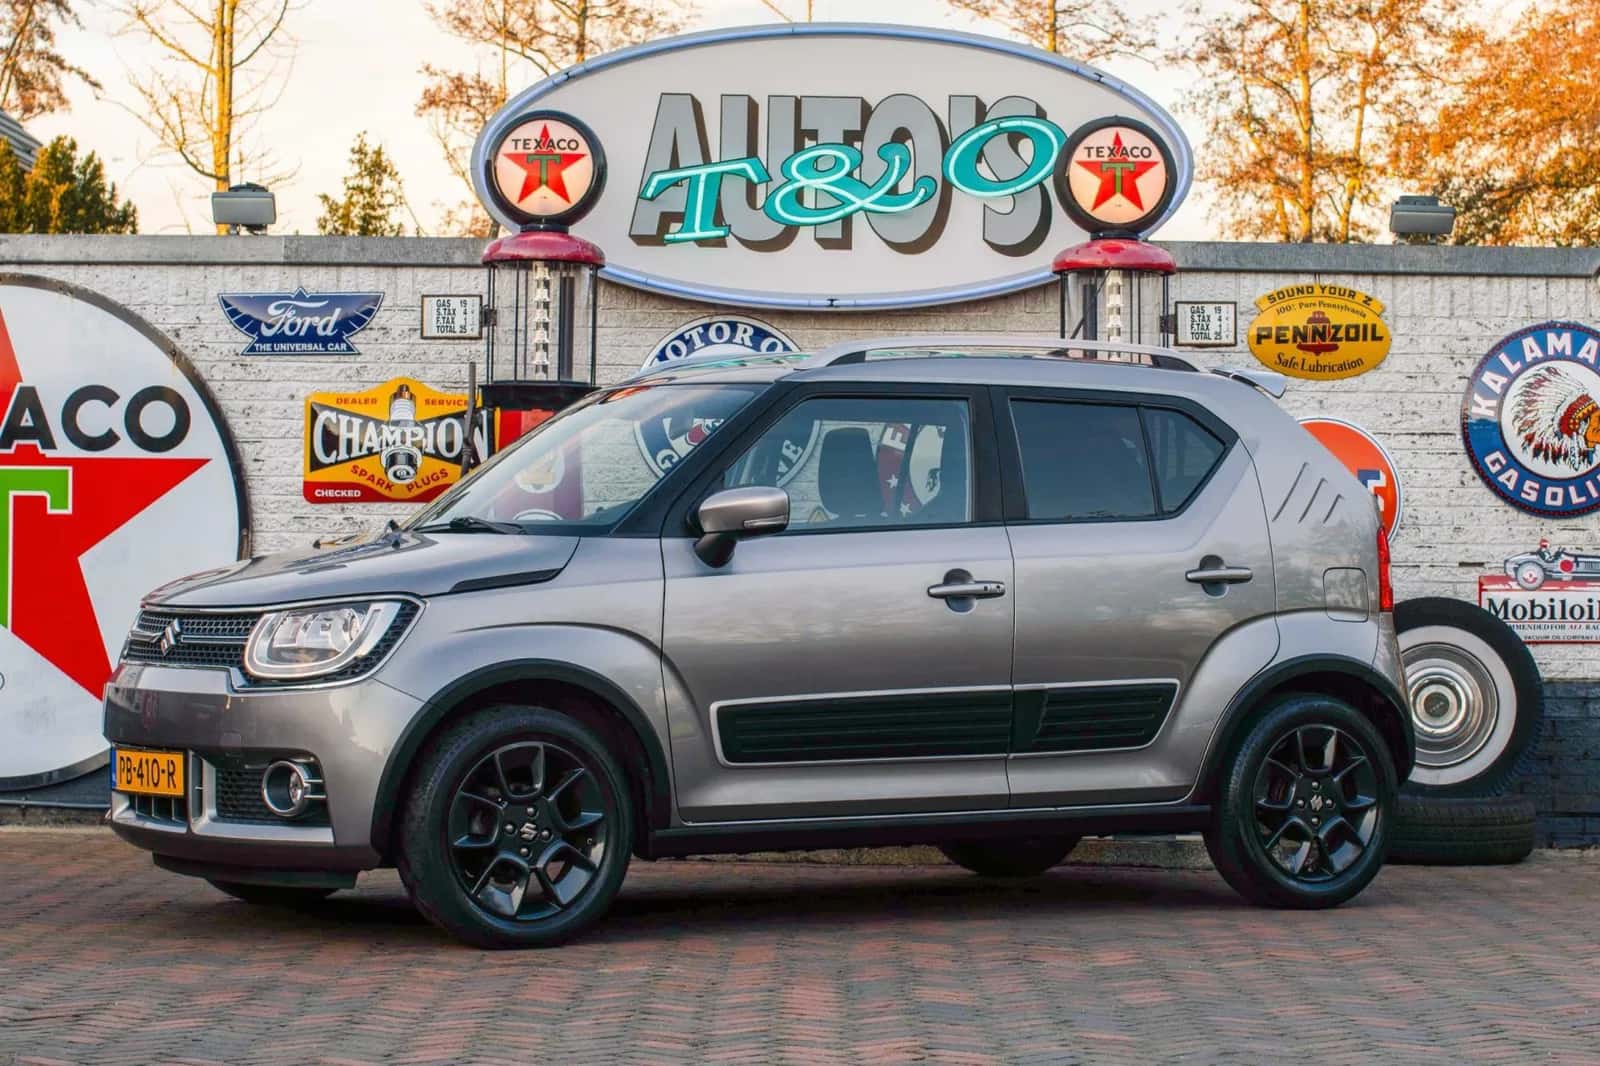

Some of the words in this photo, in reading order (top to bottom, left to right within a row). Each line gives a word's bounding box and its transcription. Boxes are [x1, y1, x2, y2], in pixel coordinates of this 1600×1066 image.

[511, 138, 580, 151] TEXACO
[1083, 146, 1152, 159] TEXACO
[629, 93, 1051, 254] AUTO'S
[436, 299, 451, 308] GAS
[1267, 285, 1315, 304] SOUND
[1319, 285, 1356, 300] YOUR
[260, 300, 342, 337] Ford
[1190, 306, 1205, 314] GAS
[1299, 301, 1317, 310] Pure
[1318, 300, 1367, 319] Pennsylvania
[436, 325, 456, 333] TOTAL
[1190, 331, 1212, 340] TOTAL
[1256, 323, 1384, 345] PENNZOIL
[254, 342, 272, 351] THE
[273, 342, 325, 351] UNIVERSAL
[327, 342, 347, 351] CAR
[655, 322, 754, 361] OTOR
[1274, 352, 1298, 370] Safe
[1300, 356, 1364, 373] Lubrication
[1472, 332, 1600, 417] KALAMA
[0, 385, 191, 453] ACO
[350, 464, 395, 492] SPARK
[406, 468, 449, 492] PLUGS
[1483, 451, 1600, 507] GASOLI
[314, 489, 361, 497] CHECKED
[119, 756, 177, 789] PB-410-R
